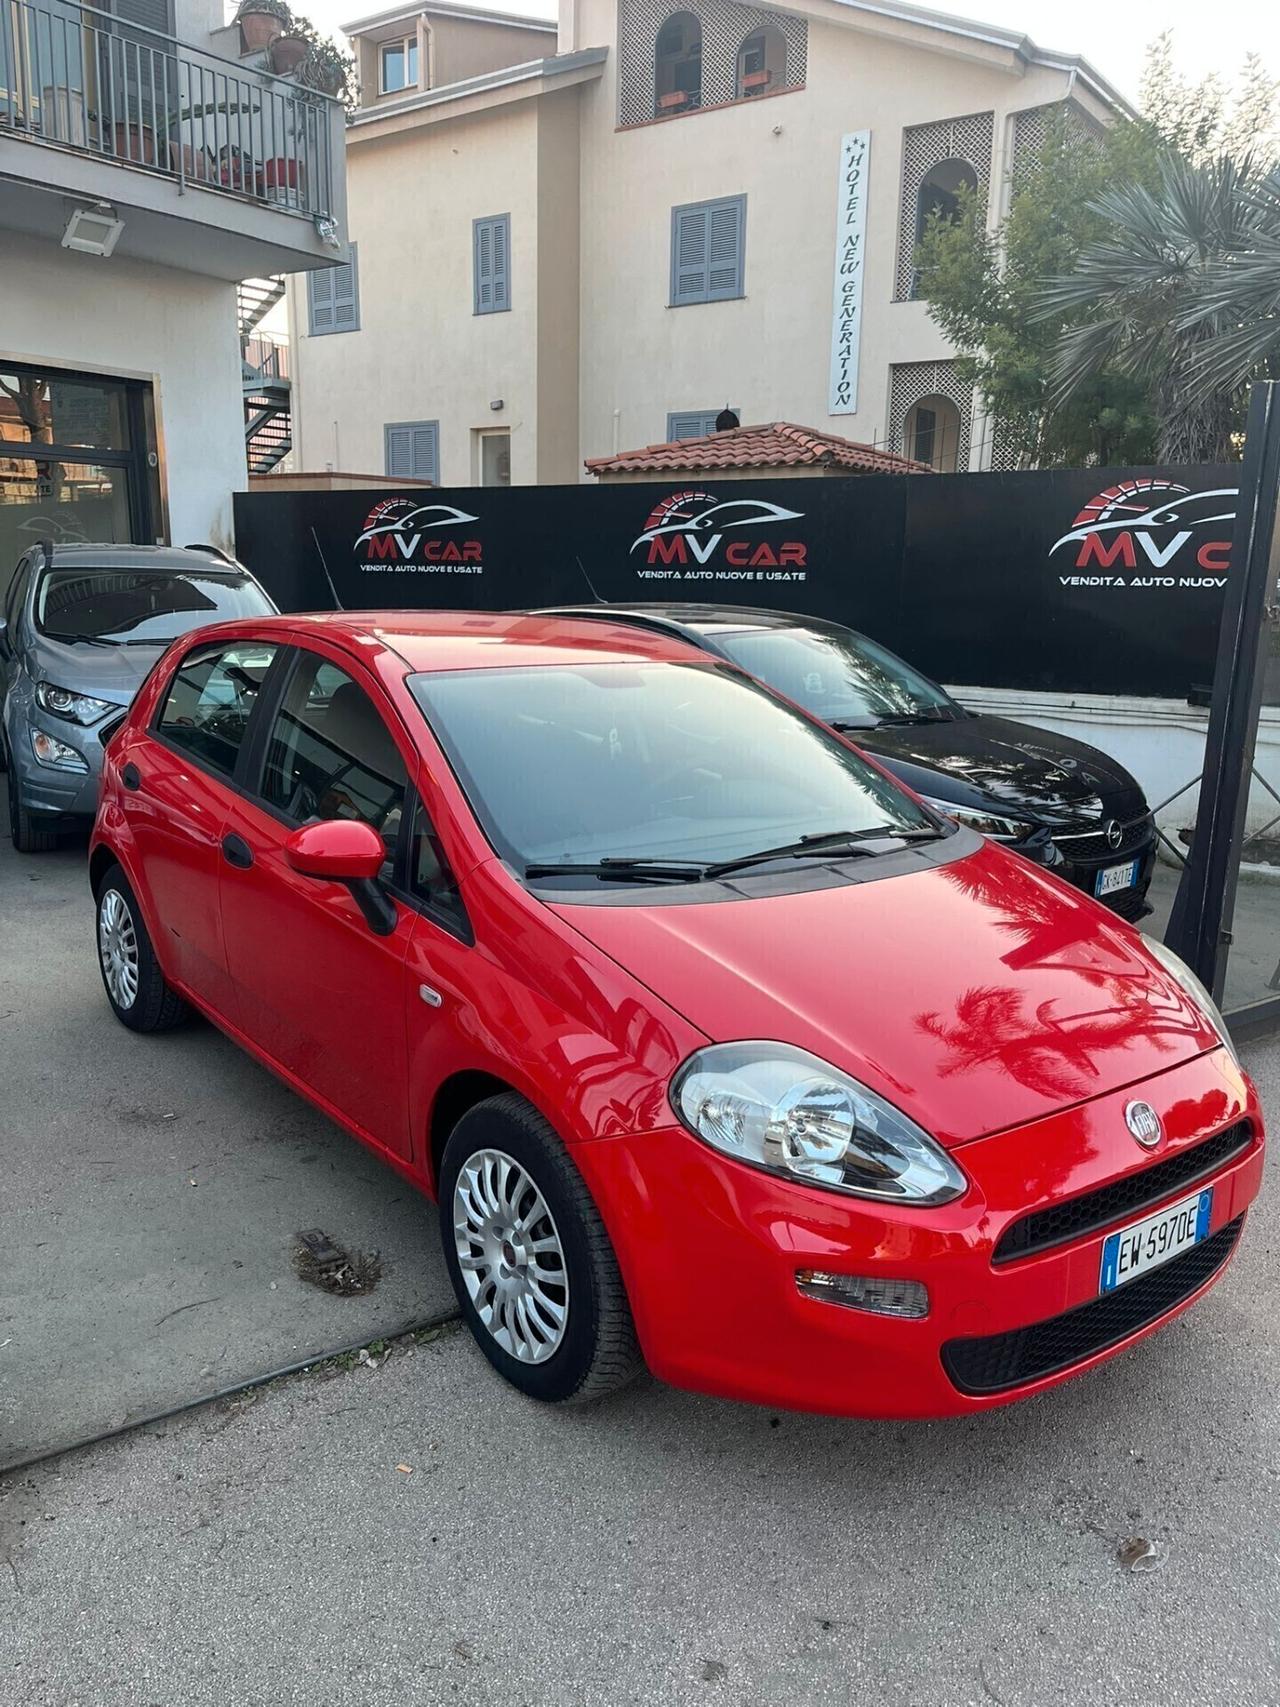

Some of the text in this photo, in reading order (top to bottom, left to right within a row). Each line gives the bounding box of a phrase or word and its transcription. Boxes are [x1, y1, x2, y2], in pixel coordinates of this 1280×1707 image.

[834, 152, 863, 407] HOTEL NEW GENERATION
[367, 533, 483, 561] MV CAR
[647, 534, 807, 566] MV CAR
[1075, 531, 1193, 569] MV
[360, 564, 483, 574] VENDITA AUTO NUOVE E USATE
[637, 570, 807, 581] VENDITA AUTO NUOVE E USATE
[1058, 576, 1229, 589] VENDITA AUTO NUOV
[1118, 1205, 1198, 1275] EW 597DE
